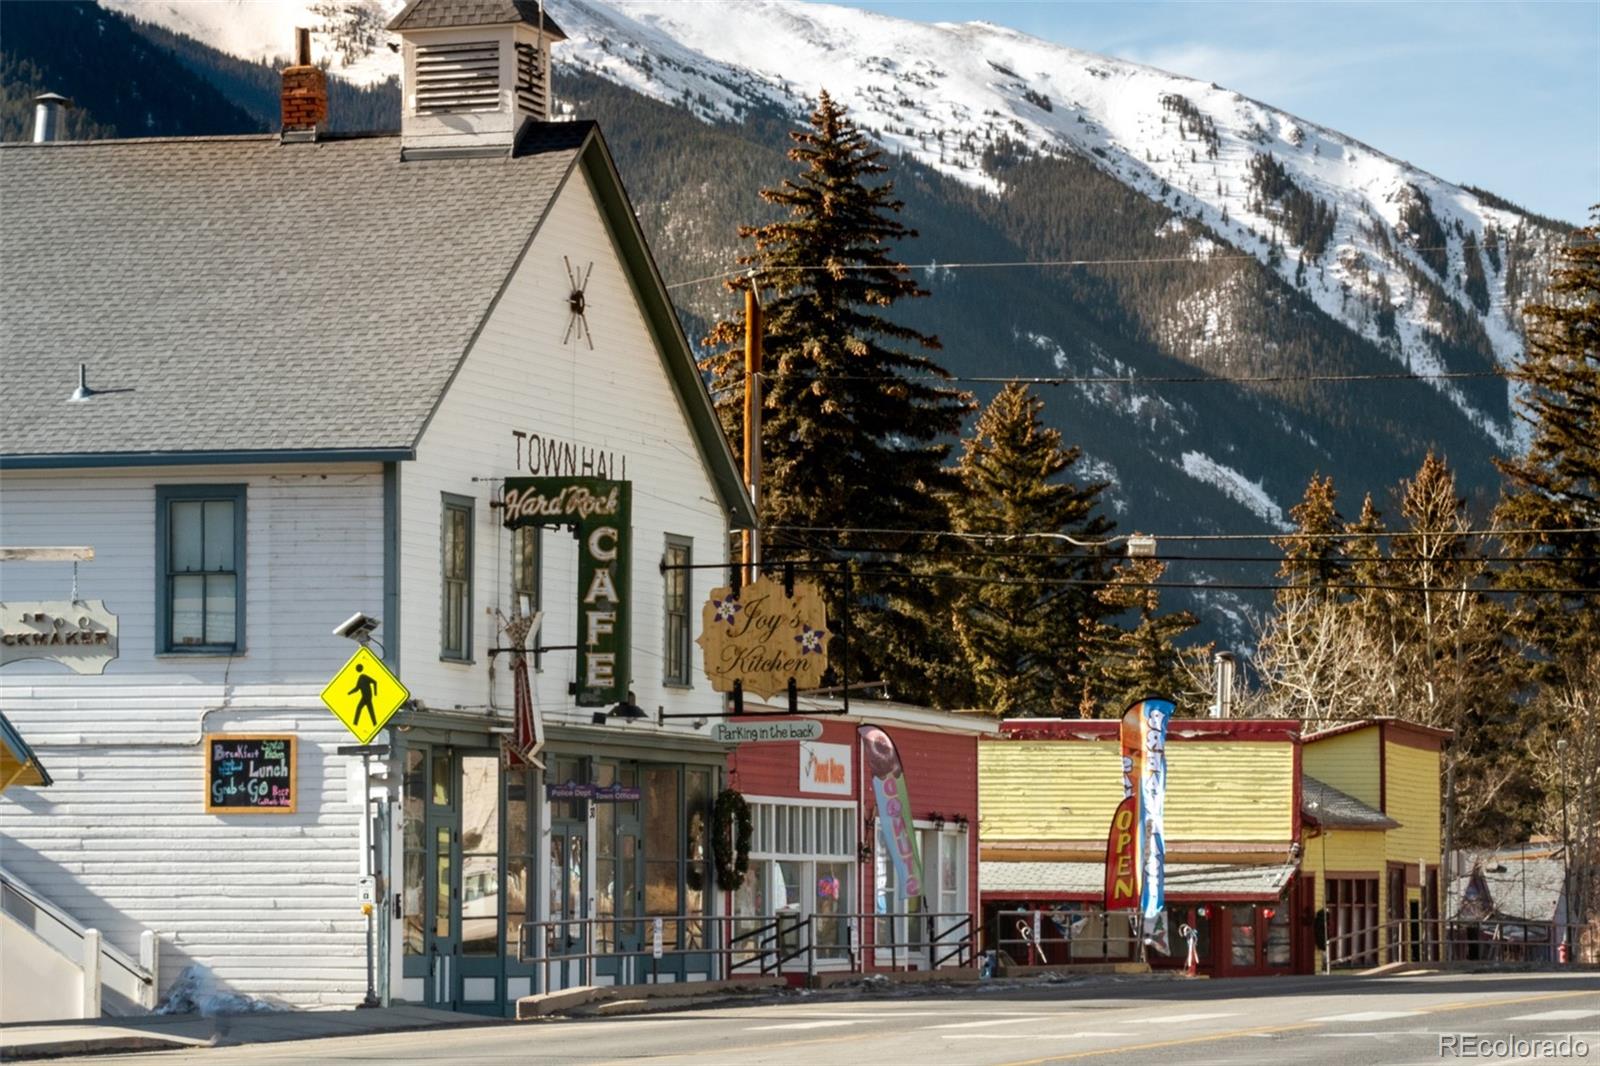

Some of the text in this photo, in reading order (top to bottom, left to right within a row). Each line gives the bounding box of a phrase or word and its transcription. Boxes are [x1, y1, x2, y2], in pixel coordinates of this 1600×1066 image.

[512, 430, 577, 477] TOWN
[505, 485, 619, 521] Hard Rock
[583, 526, 620, 688] CAFE
[726, 595, 802, 643] Joy's
[716, 644, 810, 673] Kitchen
[718, 724, 815, 741] Parking in the back
[249, 758, 288, 777] Lunch
[212, 777, 238, 803] Grab
[1114, 810, 1134, 899] OPEN
